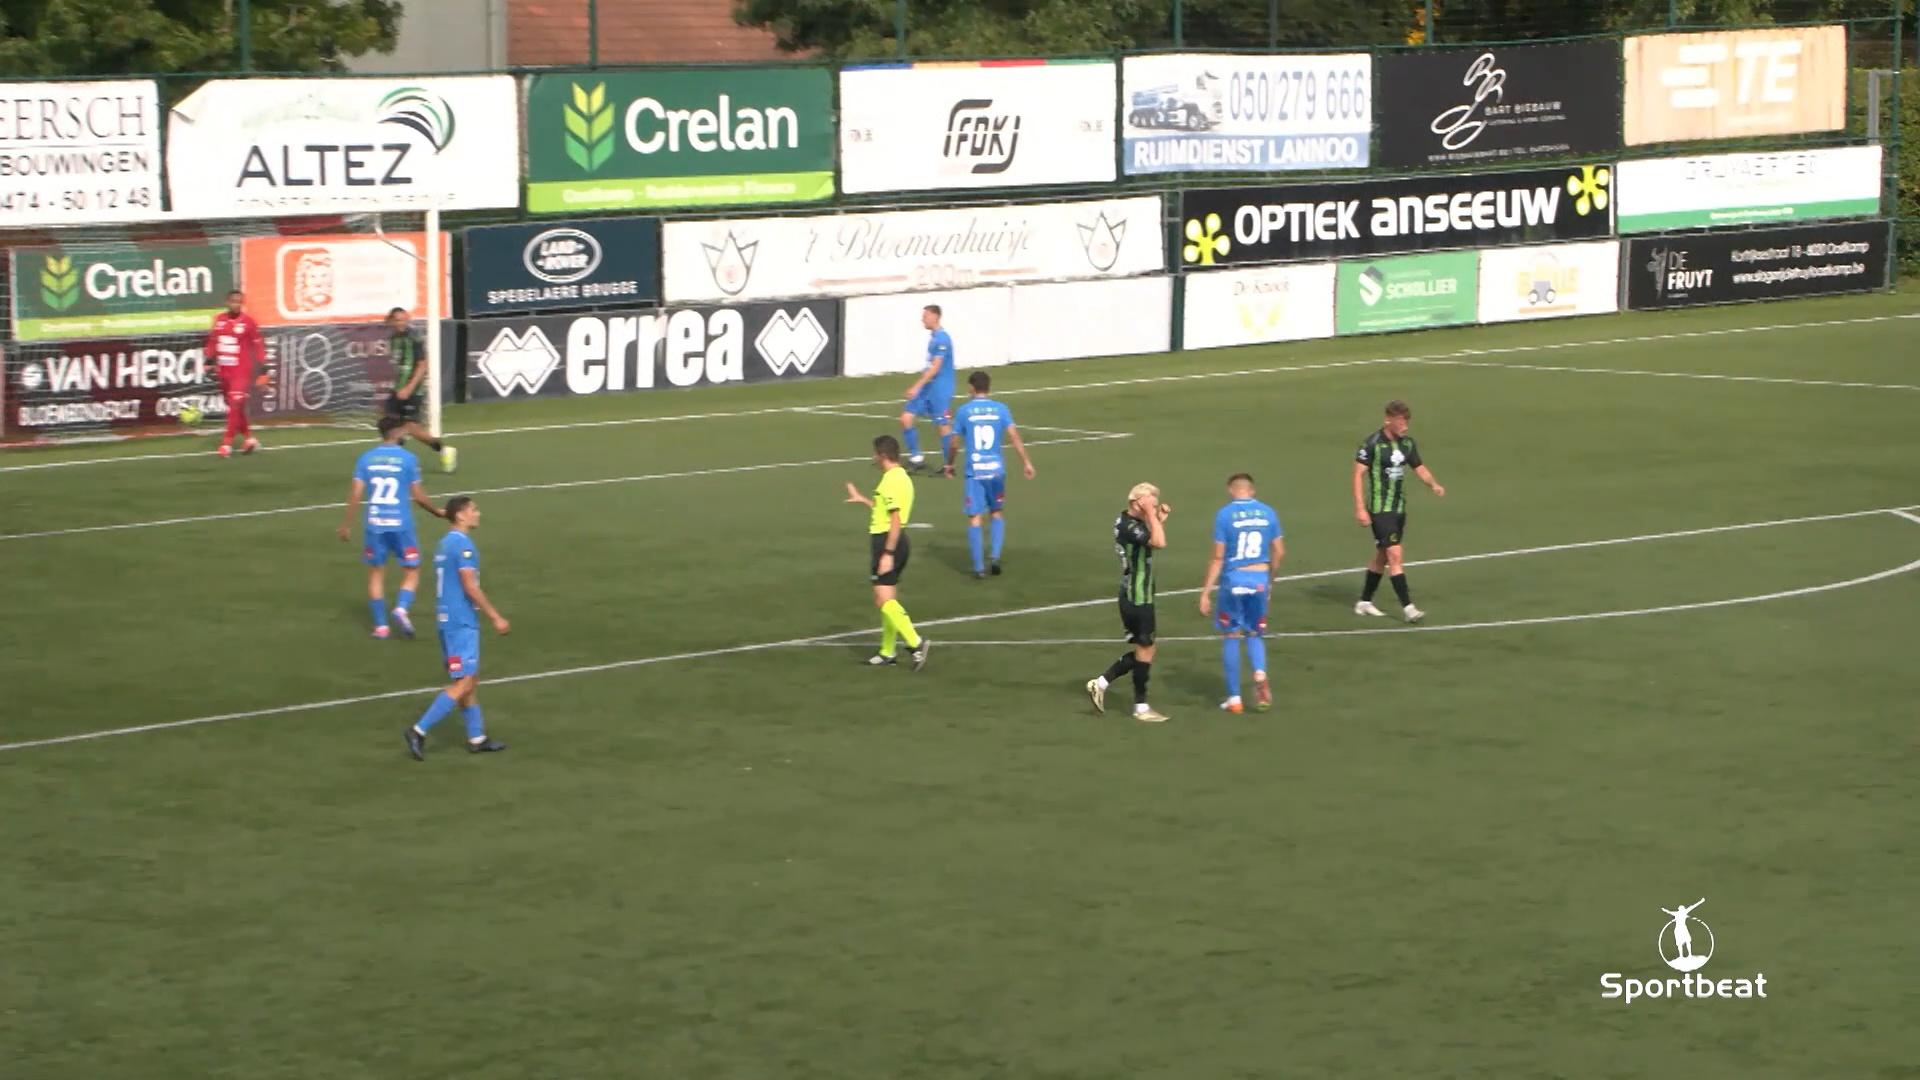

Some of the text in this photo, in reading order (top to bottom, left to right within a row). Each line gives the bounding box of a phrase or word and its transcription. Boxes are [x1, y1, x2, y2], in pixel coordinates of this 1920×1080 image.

[1230, 69, 1364, 121] 050/279 666
[624, 93, 798, 154] Crelan
[236, 143, 412, 187] ALTEZ
[1134, 137, 1358, 167] RUIMDIENST LANNOO
[1234, 200, 1360, 245] OPTIEK
[85, 259, 212, 300] Crelan
[1667, 269, 1713, 290] FRUYT
[1669, 251, 1688, 270] DE
[566, 309, 744, 394] errea
[46, 354, 110, 392] VAN
[974, 425, 994, 450] 19
[370, 477, 400, 505] 22
[1236, 531, 1262, 560] 18
